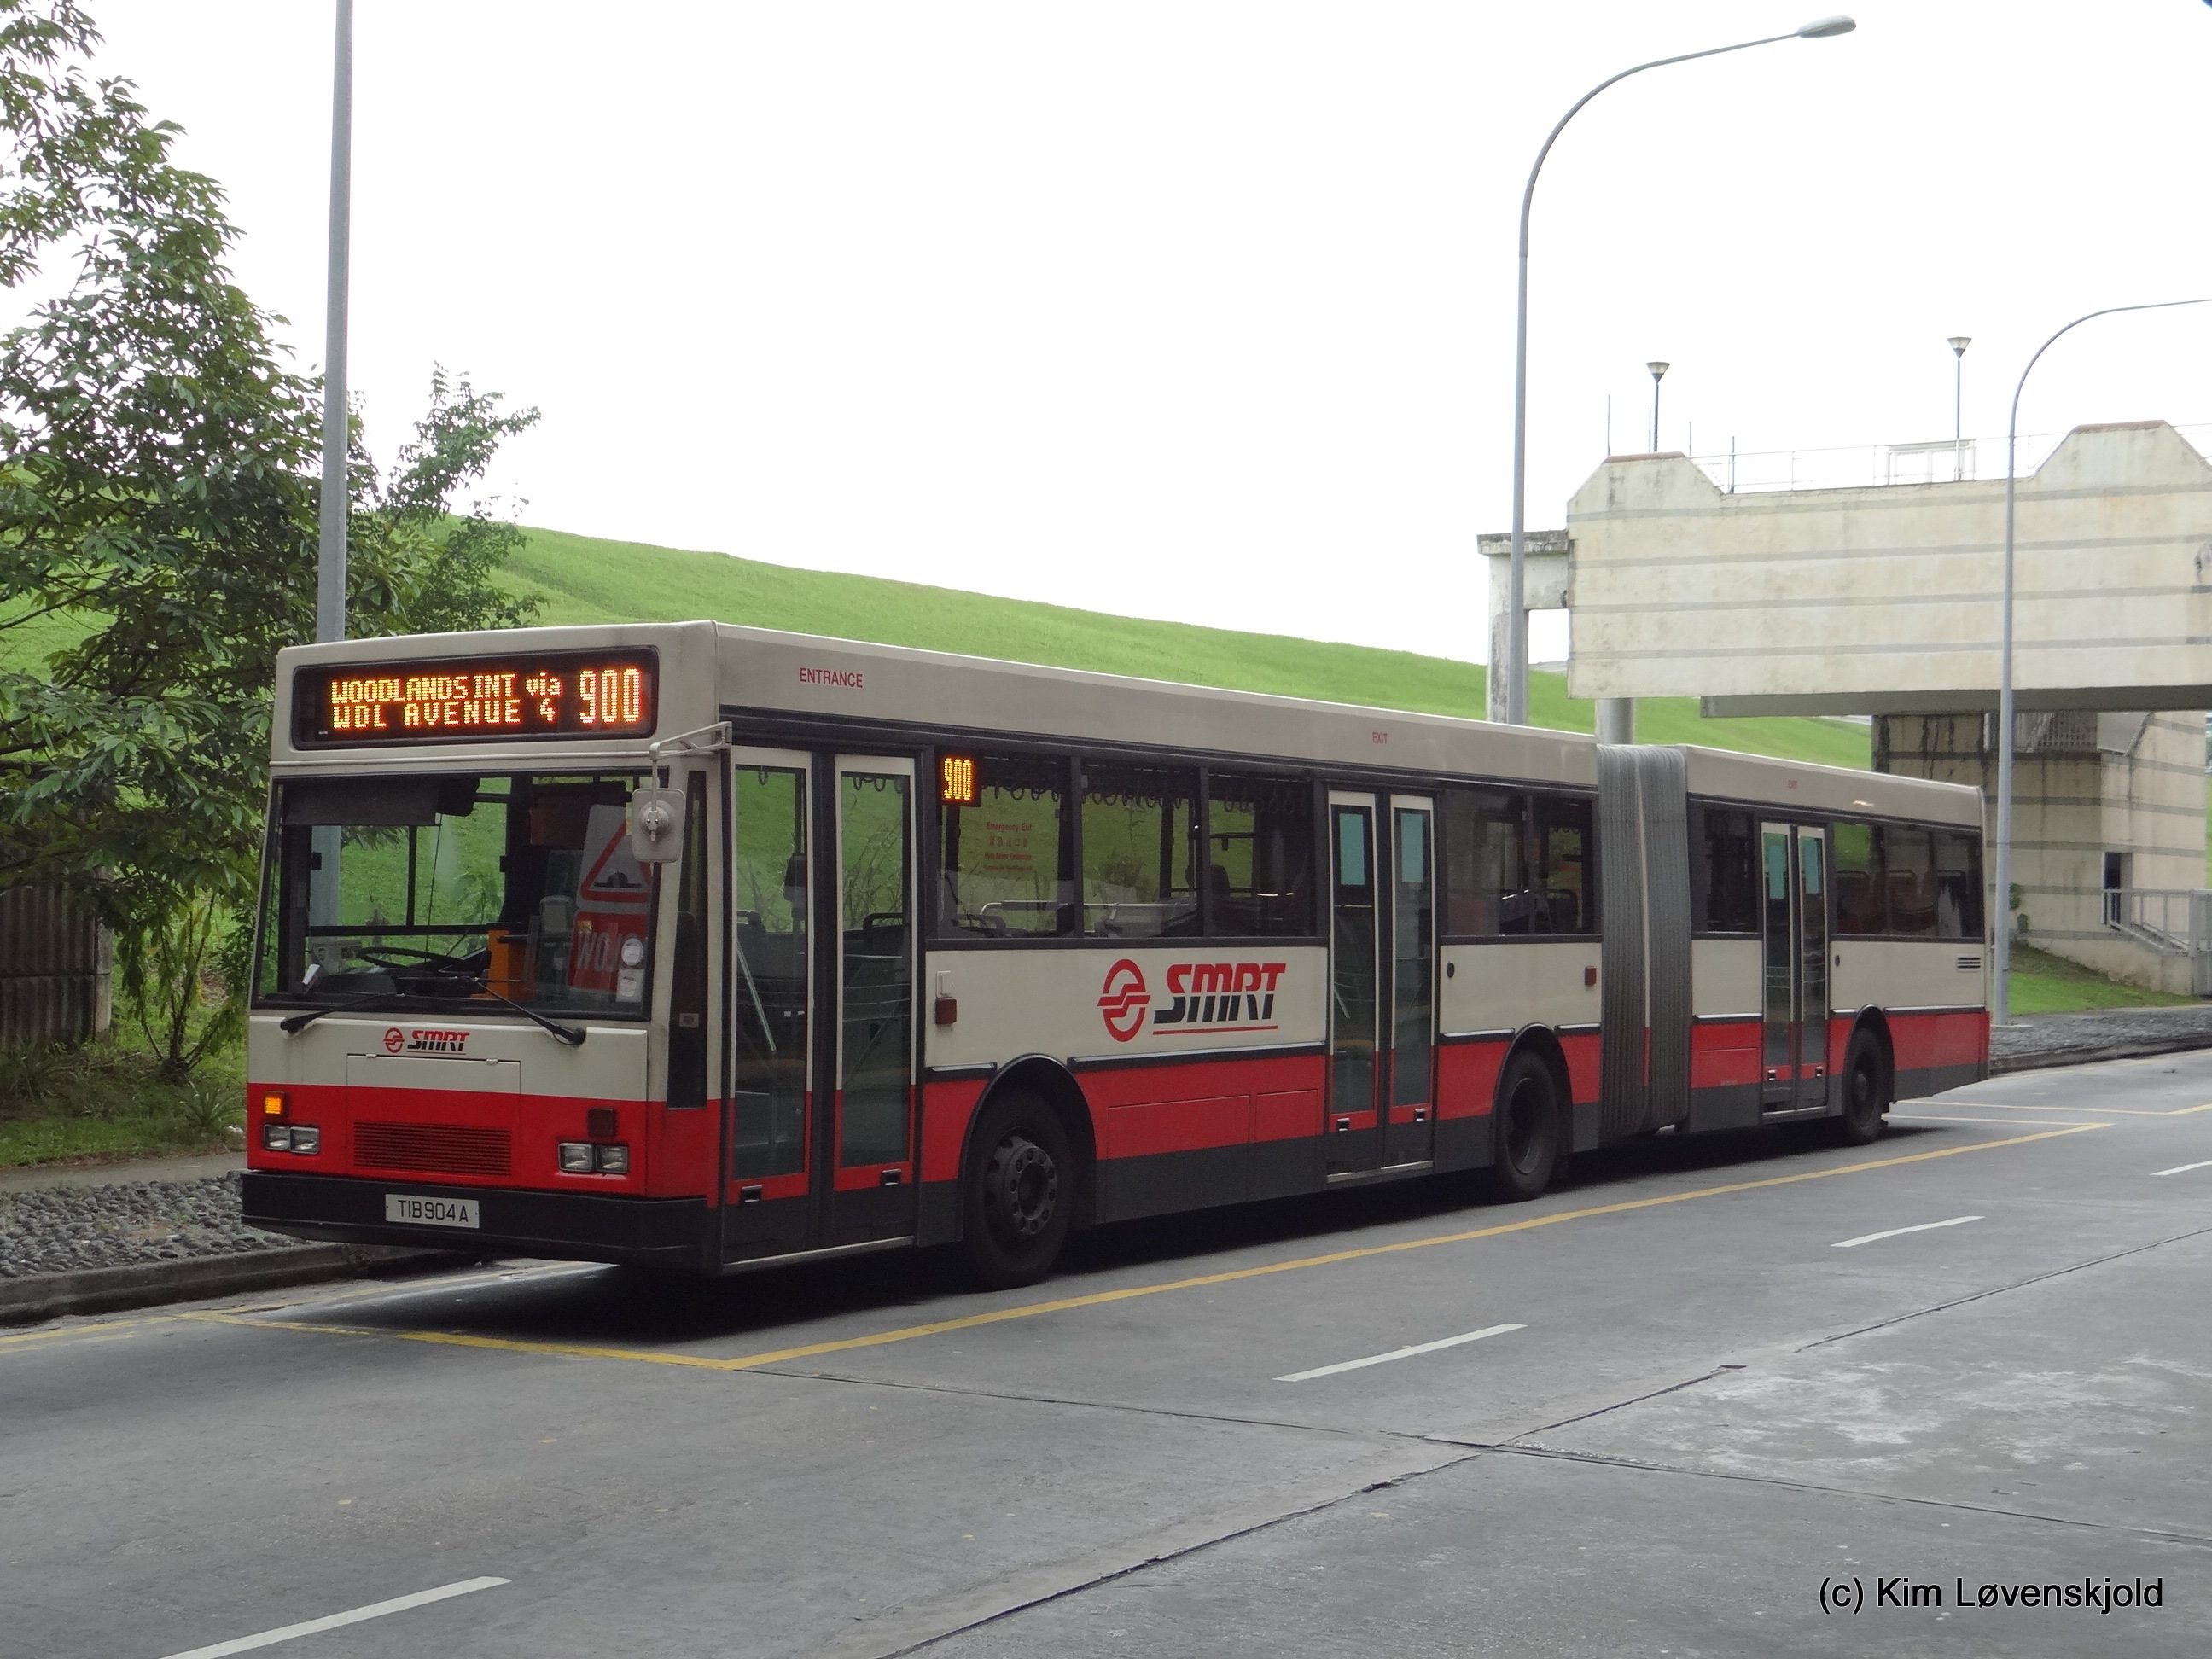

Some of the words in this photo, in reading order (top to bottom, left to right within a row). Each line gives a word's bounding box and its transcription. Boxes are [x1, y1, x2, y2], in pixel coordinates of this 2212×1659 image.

[331, 676, 469, 704] WOODLANDS
[473, 673, 517, 699] INT
[525, 671, 562, 697] via
[799, 667, 864, 689] ENTRANCE
[579, 668, 639, 725] 900
[333, 704, 387, 729] WDL
[404, 699, 521, 726] AVENUE
[539, 697, 556, 722] 4
[1371, 731, 1388, 744] EXIT
[943, 758, 972, 800] 900
[1153, 963, 1287, 1025] SMRT
[406, 1030, 470, 1051] SMRT
[398, 1199, 469, 1223] TIB904A
